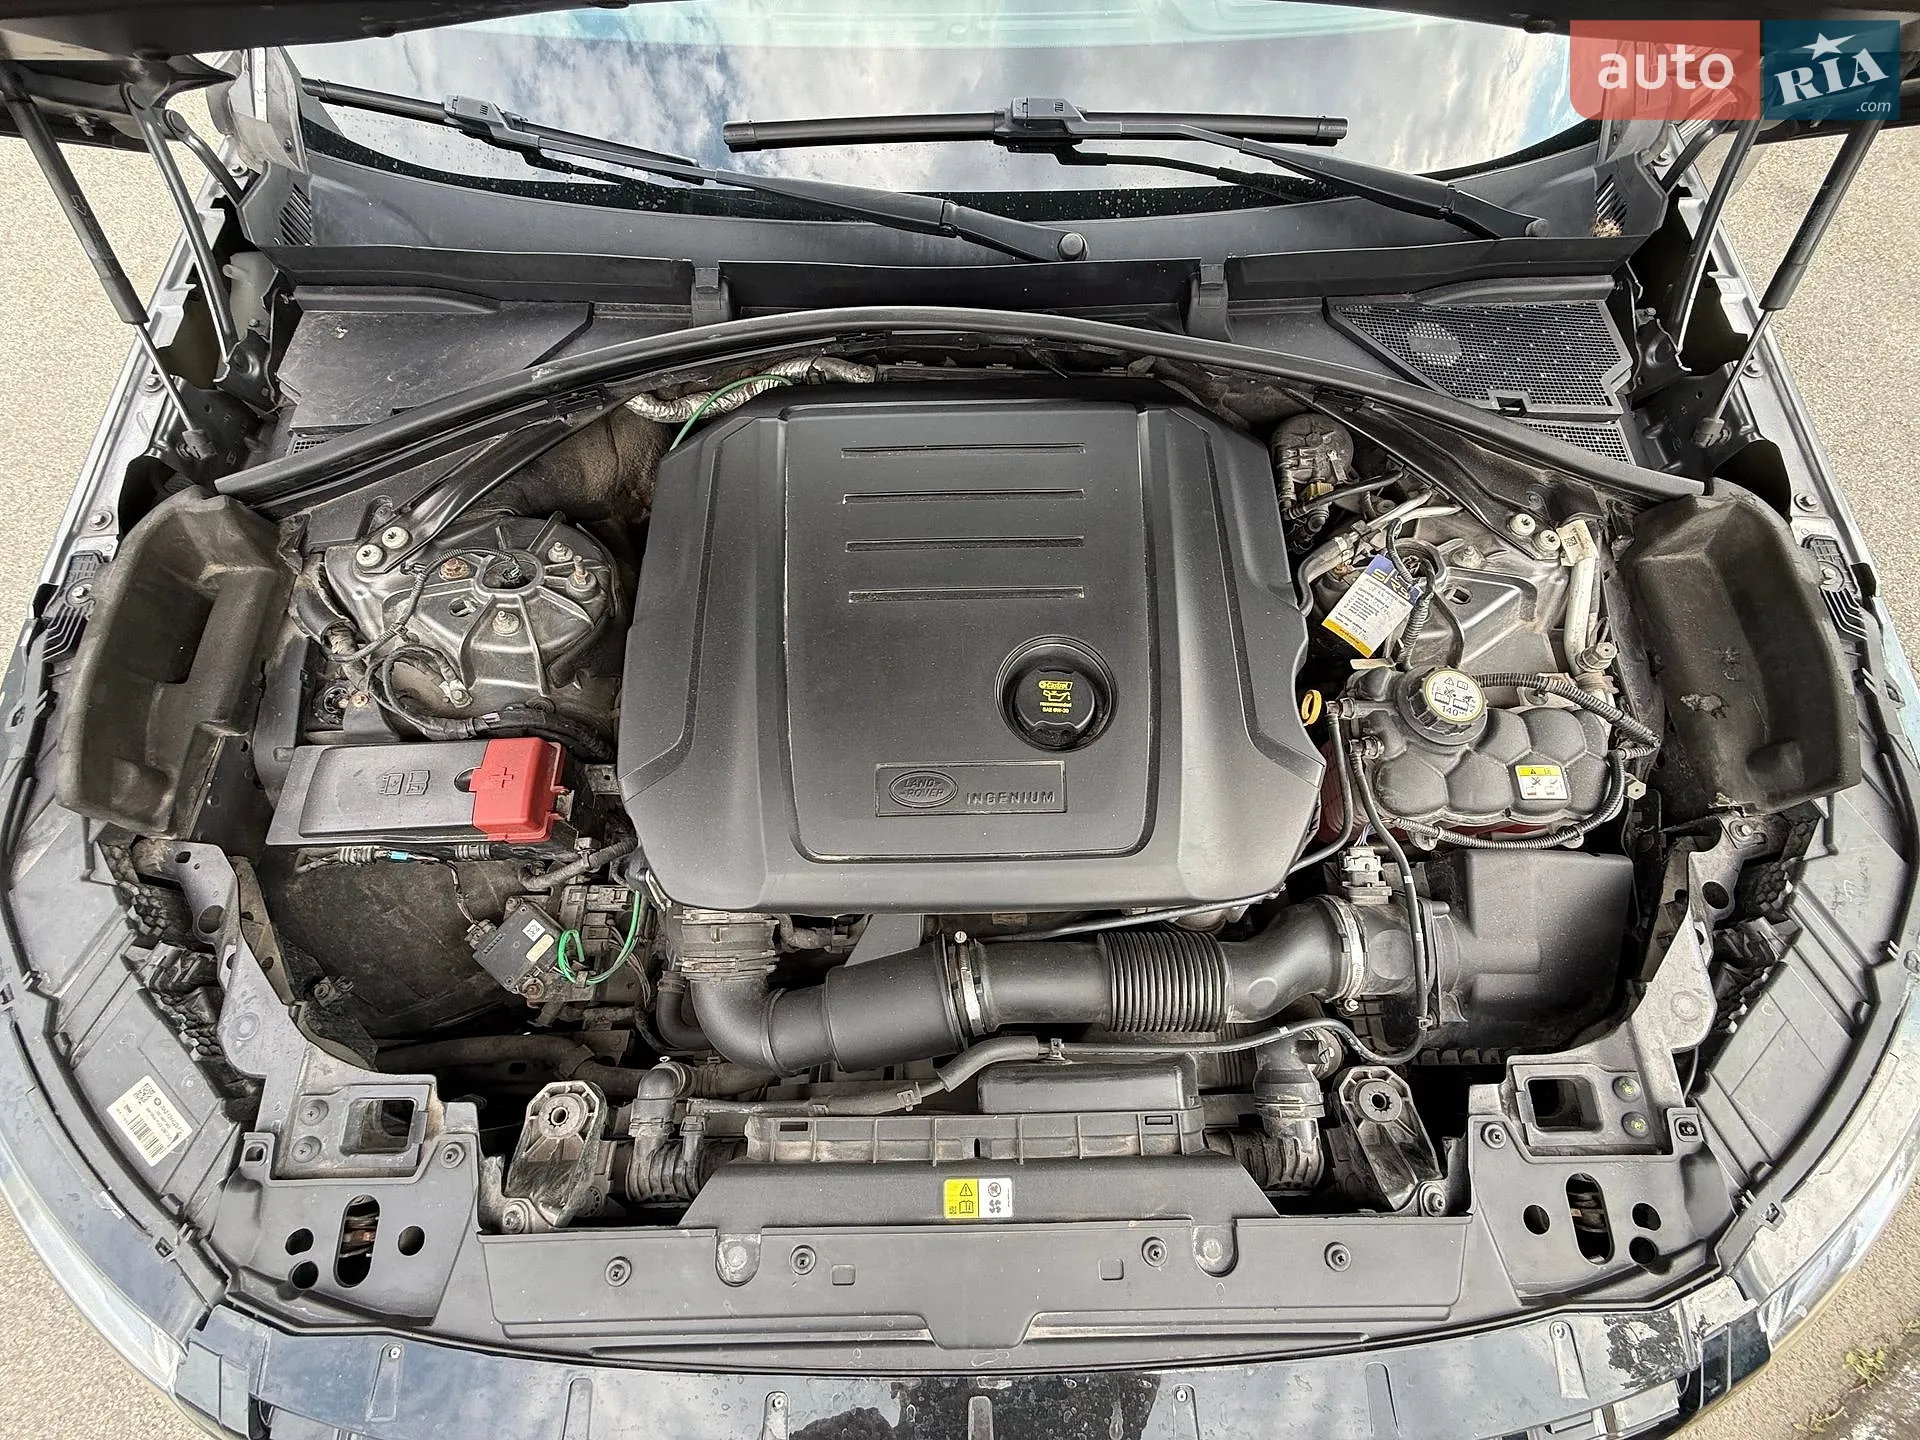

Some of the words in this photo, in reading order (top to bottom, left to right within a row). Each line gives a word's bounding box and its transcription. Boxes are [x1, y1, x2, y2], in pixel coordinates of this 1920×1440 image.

[1442, 705, 1458, 716] 140
[904, 779, 936, 788] LAND
[906, 788, 945, 798] ROVER
[966, 791, 1056, 805] INGENIUM
